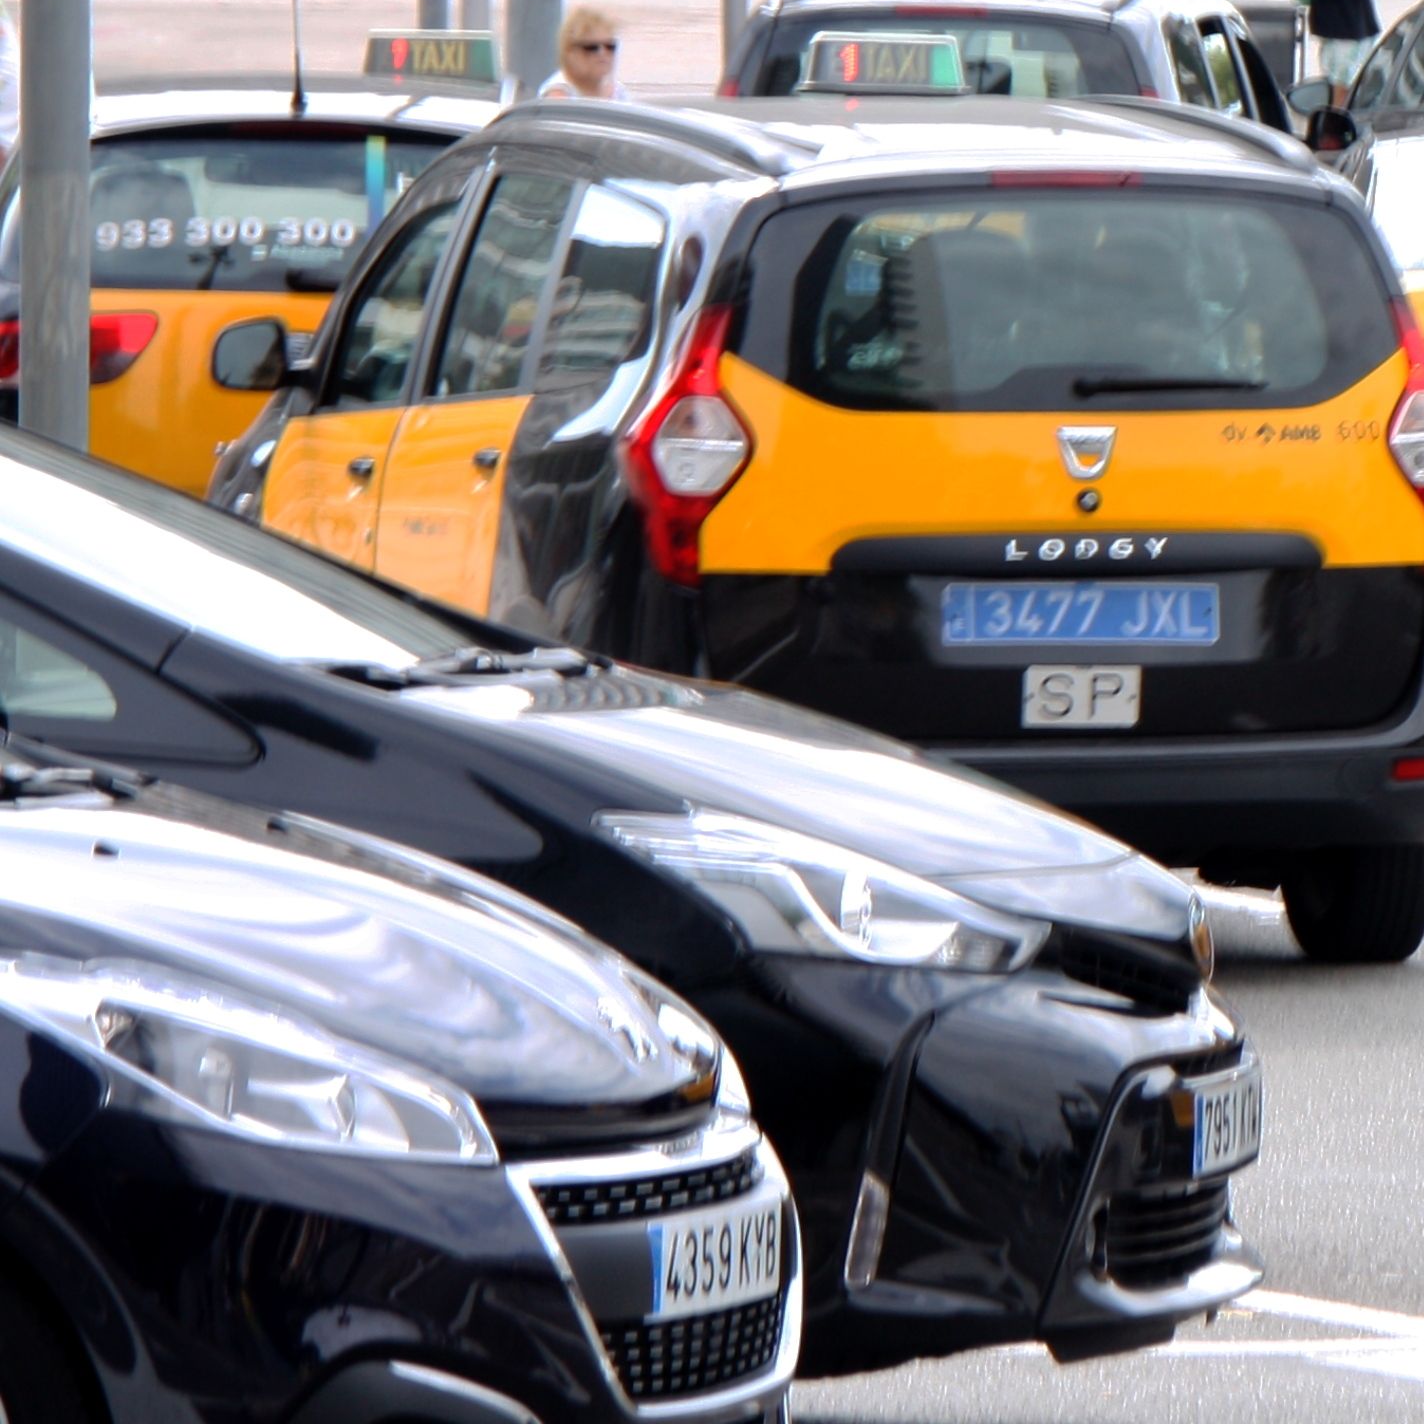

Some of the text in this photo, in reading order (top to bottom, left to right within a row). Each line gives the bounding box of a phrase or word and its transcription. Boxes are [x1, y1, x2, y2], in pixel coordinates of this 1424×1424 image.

[412, 40, 467, 73] TAXI
[865, 44, 928, 78] TAXI
[95, 216, 355, 251] 933 300 300
[1005, 537, 1168, 561] LODGY
[985, 590, 1104, 636] 3477
[1121, 589, 1209, 636] JXL
[1204, 1092, 1238, 1161] 7951
[665, 1209, 777, 1301] 4359 KYB
